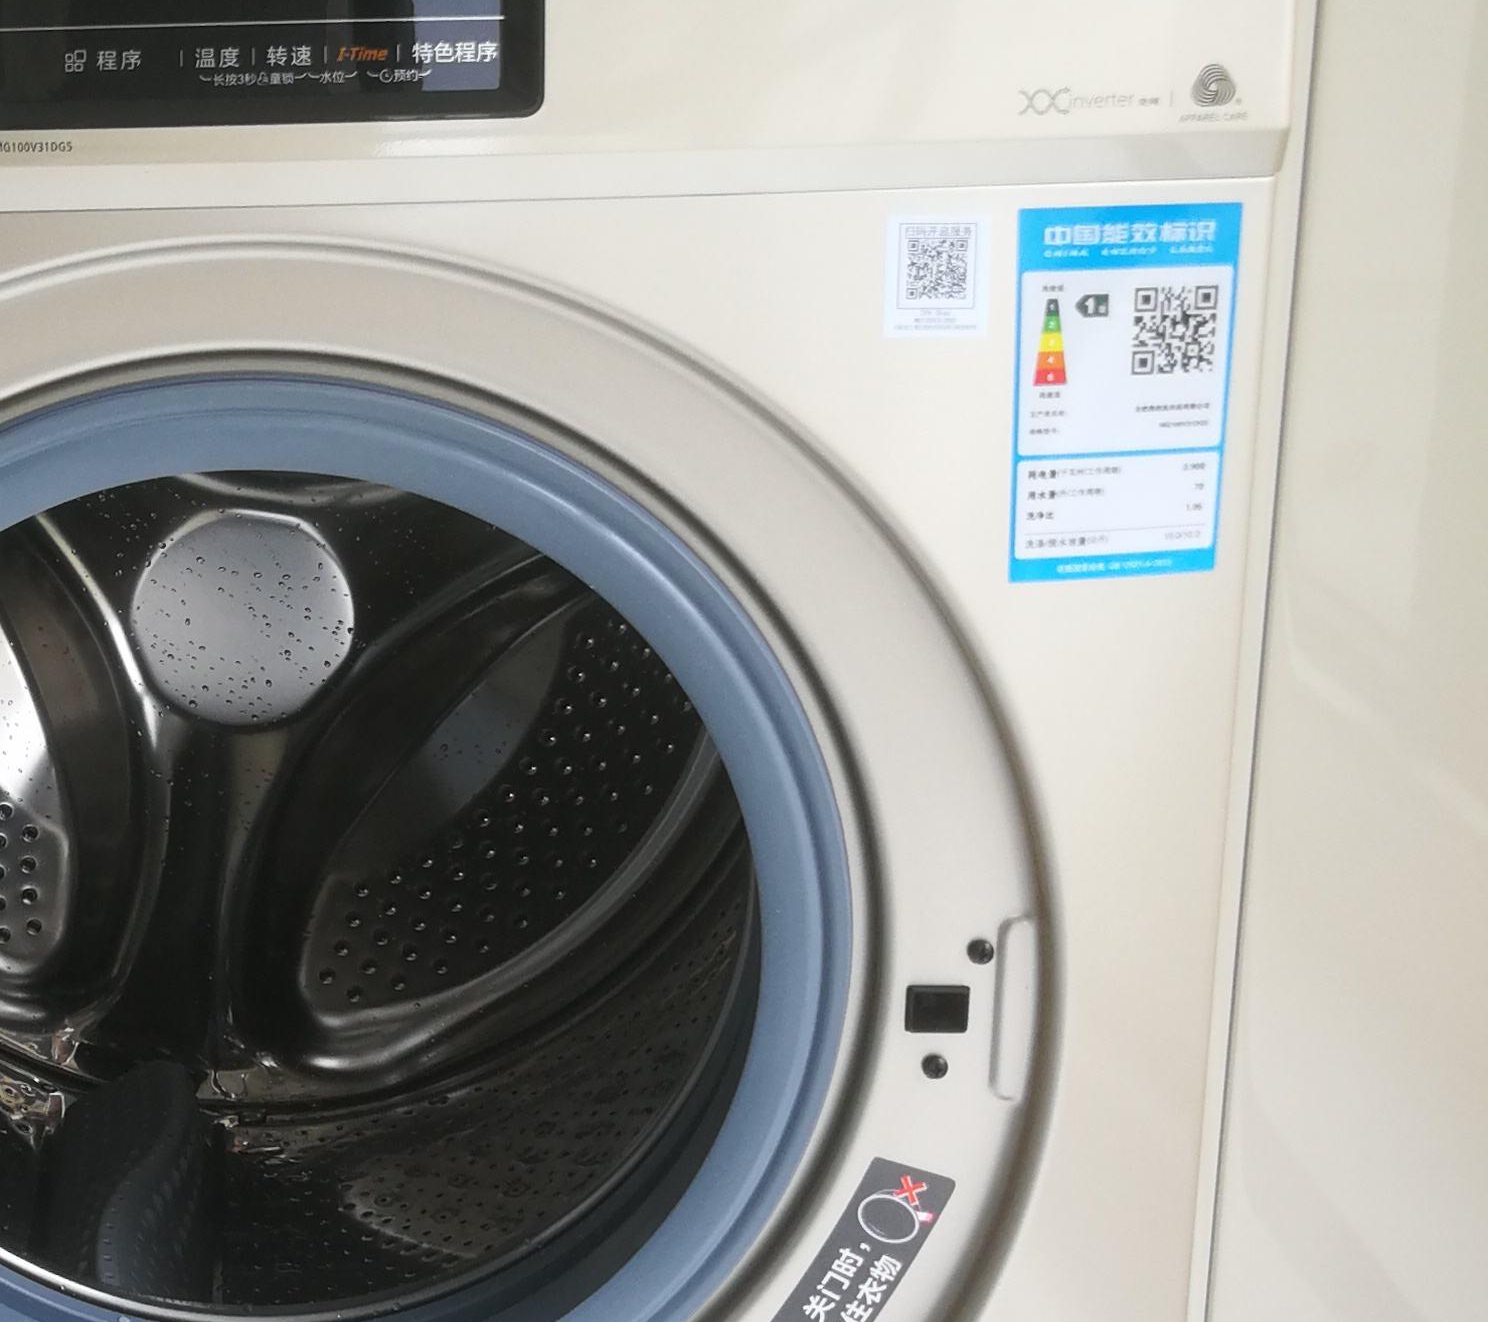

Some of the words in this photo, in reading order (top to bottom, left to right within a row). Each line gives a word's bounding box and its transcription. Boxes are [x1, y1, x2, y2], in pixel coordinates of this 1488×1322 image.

[96, 49, 142, 71] 程序
[195, 47, 240, 68] 温度
[266, 45, 312, 67] 转速
[412, 41, 499, 64] 特色程序
[319, 71, 345, 84] 水位
[393, 69, 418, 83] 预约
[1044, 220, 1217, 246] 中国能效标识
